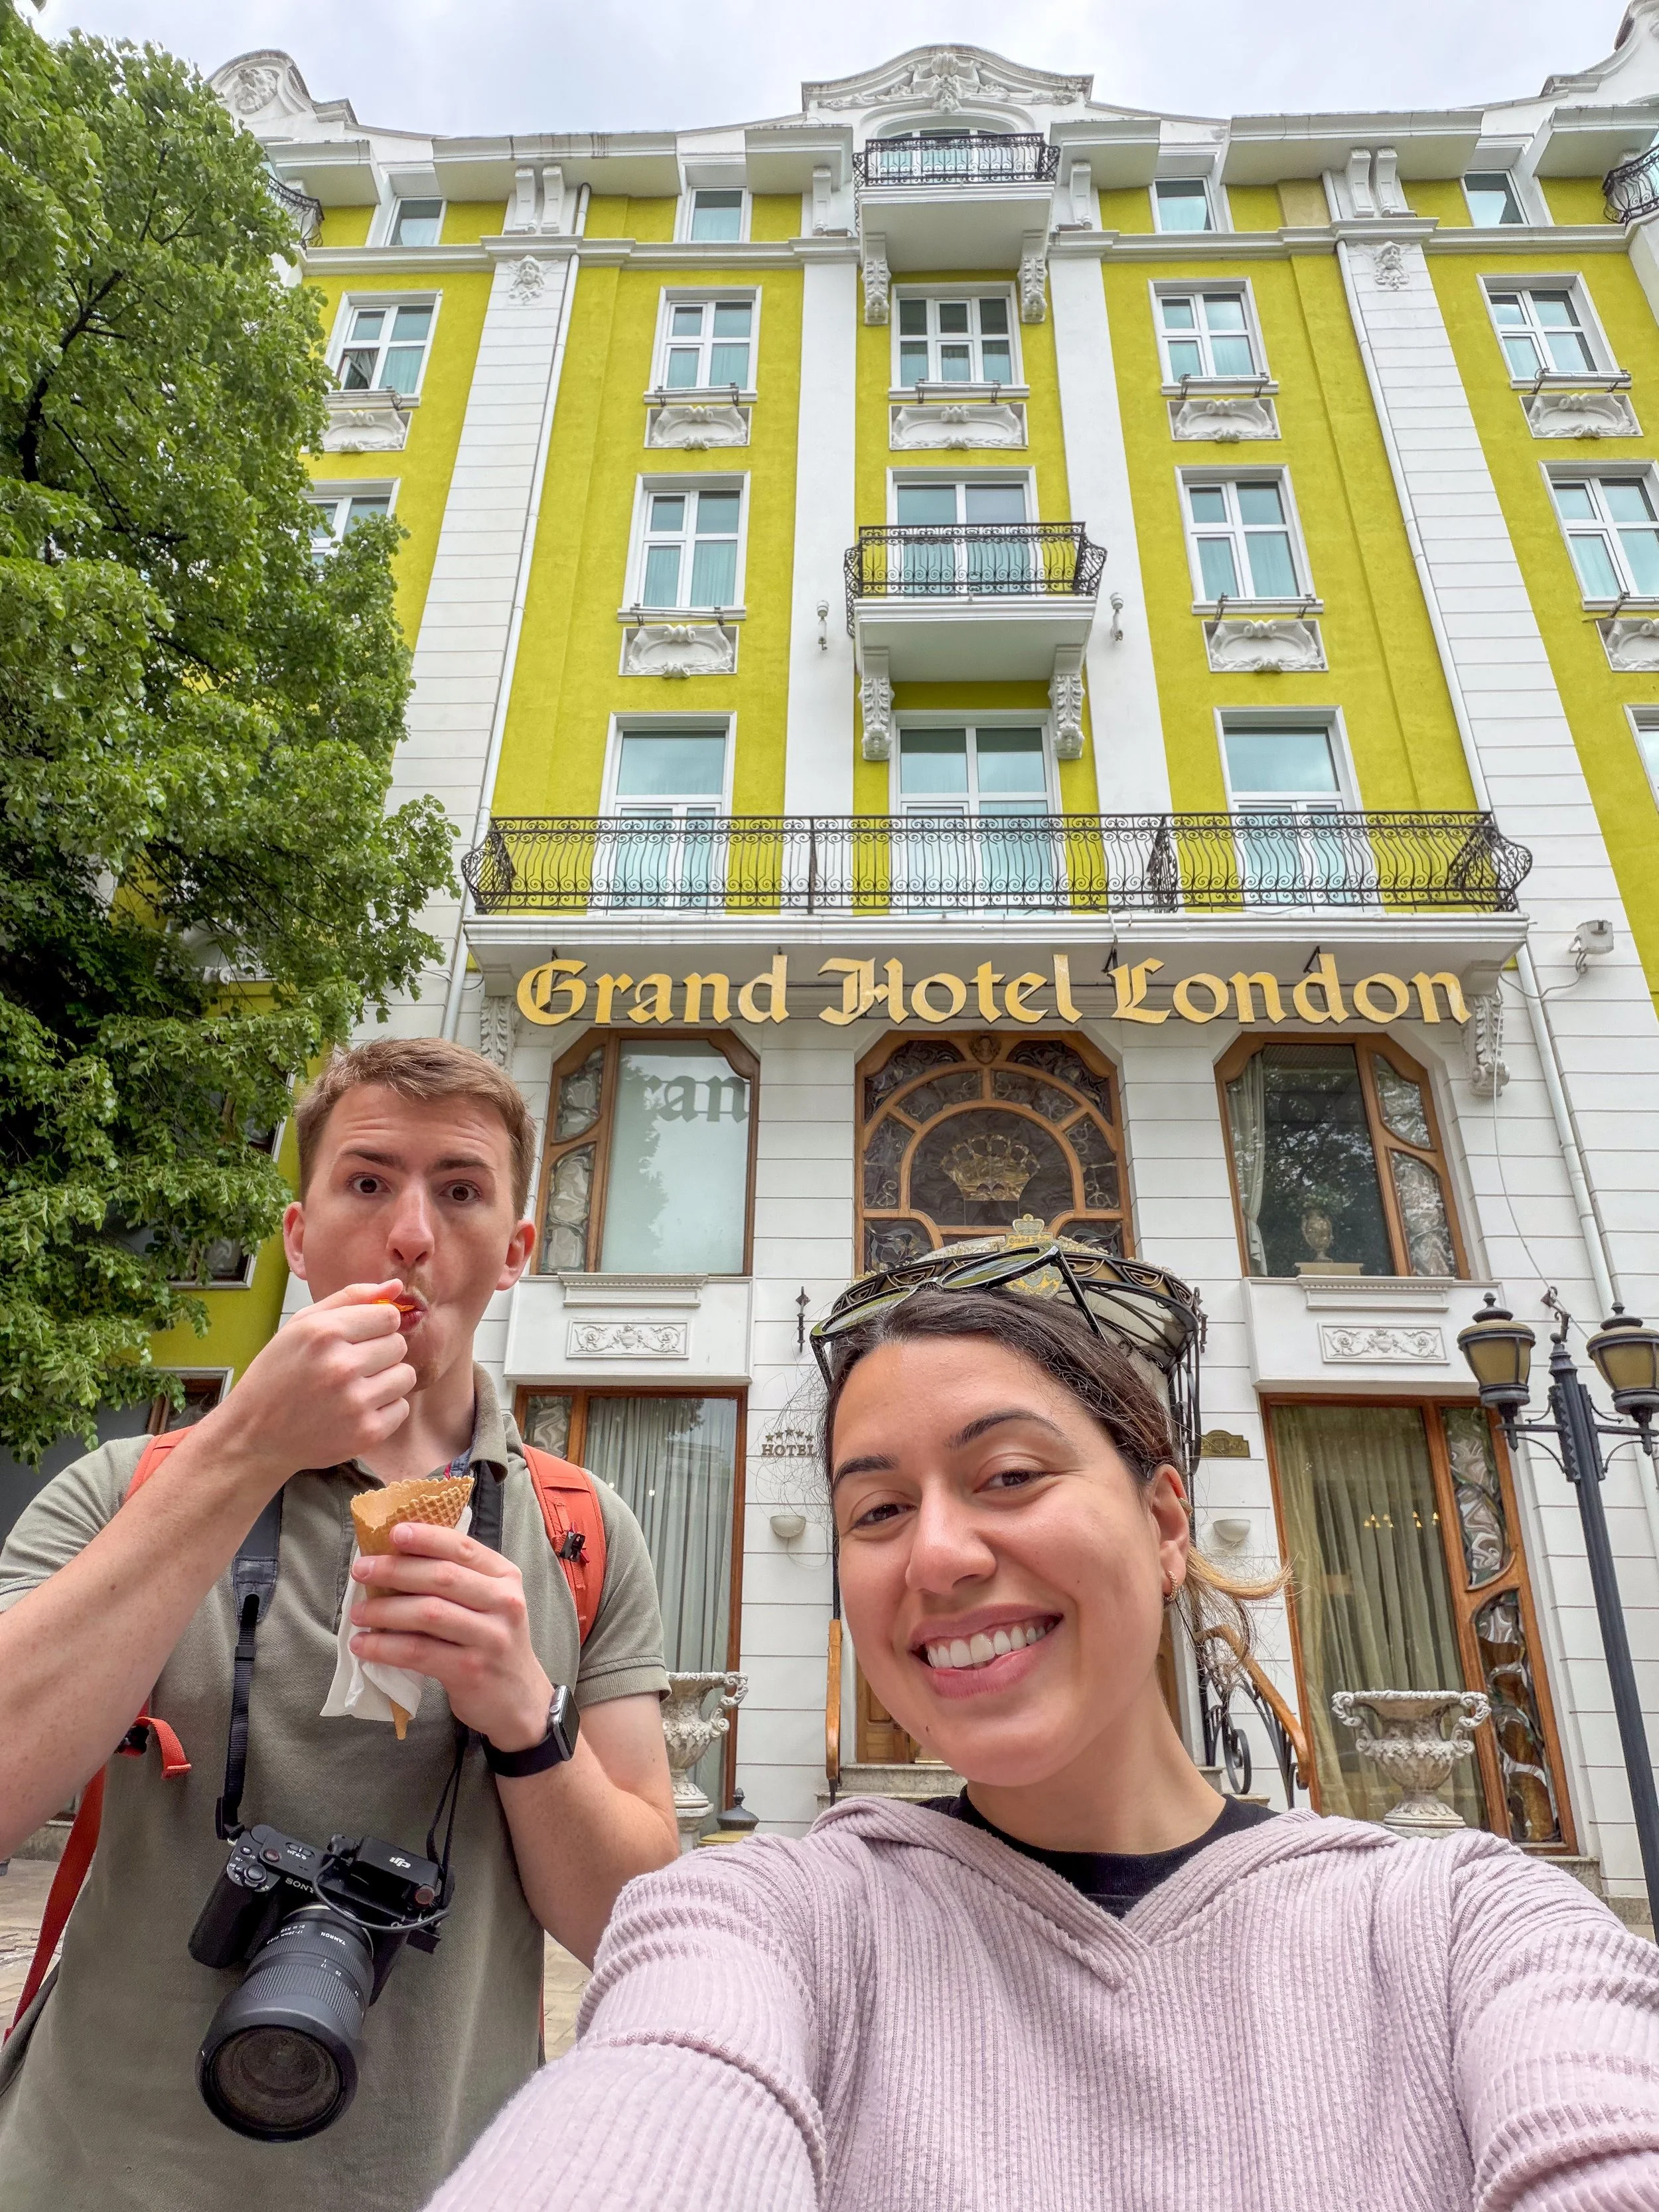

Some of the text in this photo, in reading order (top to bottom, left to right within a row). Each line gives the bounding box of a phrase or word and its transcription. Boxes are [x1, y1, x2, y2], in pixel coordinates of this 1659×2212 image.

[517, 953, 1472, 1025] Grand Hotel London
[761, 1443, 818, 1457] HOTEL
[285, 1878, 315, 1894] SONY
[320, 1931, 346, 1946] TAMRON
